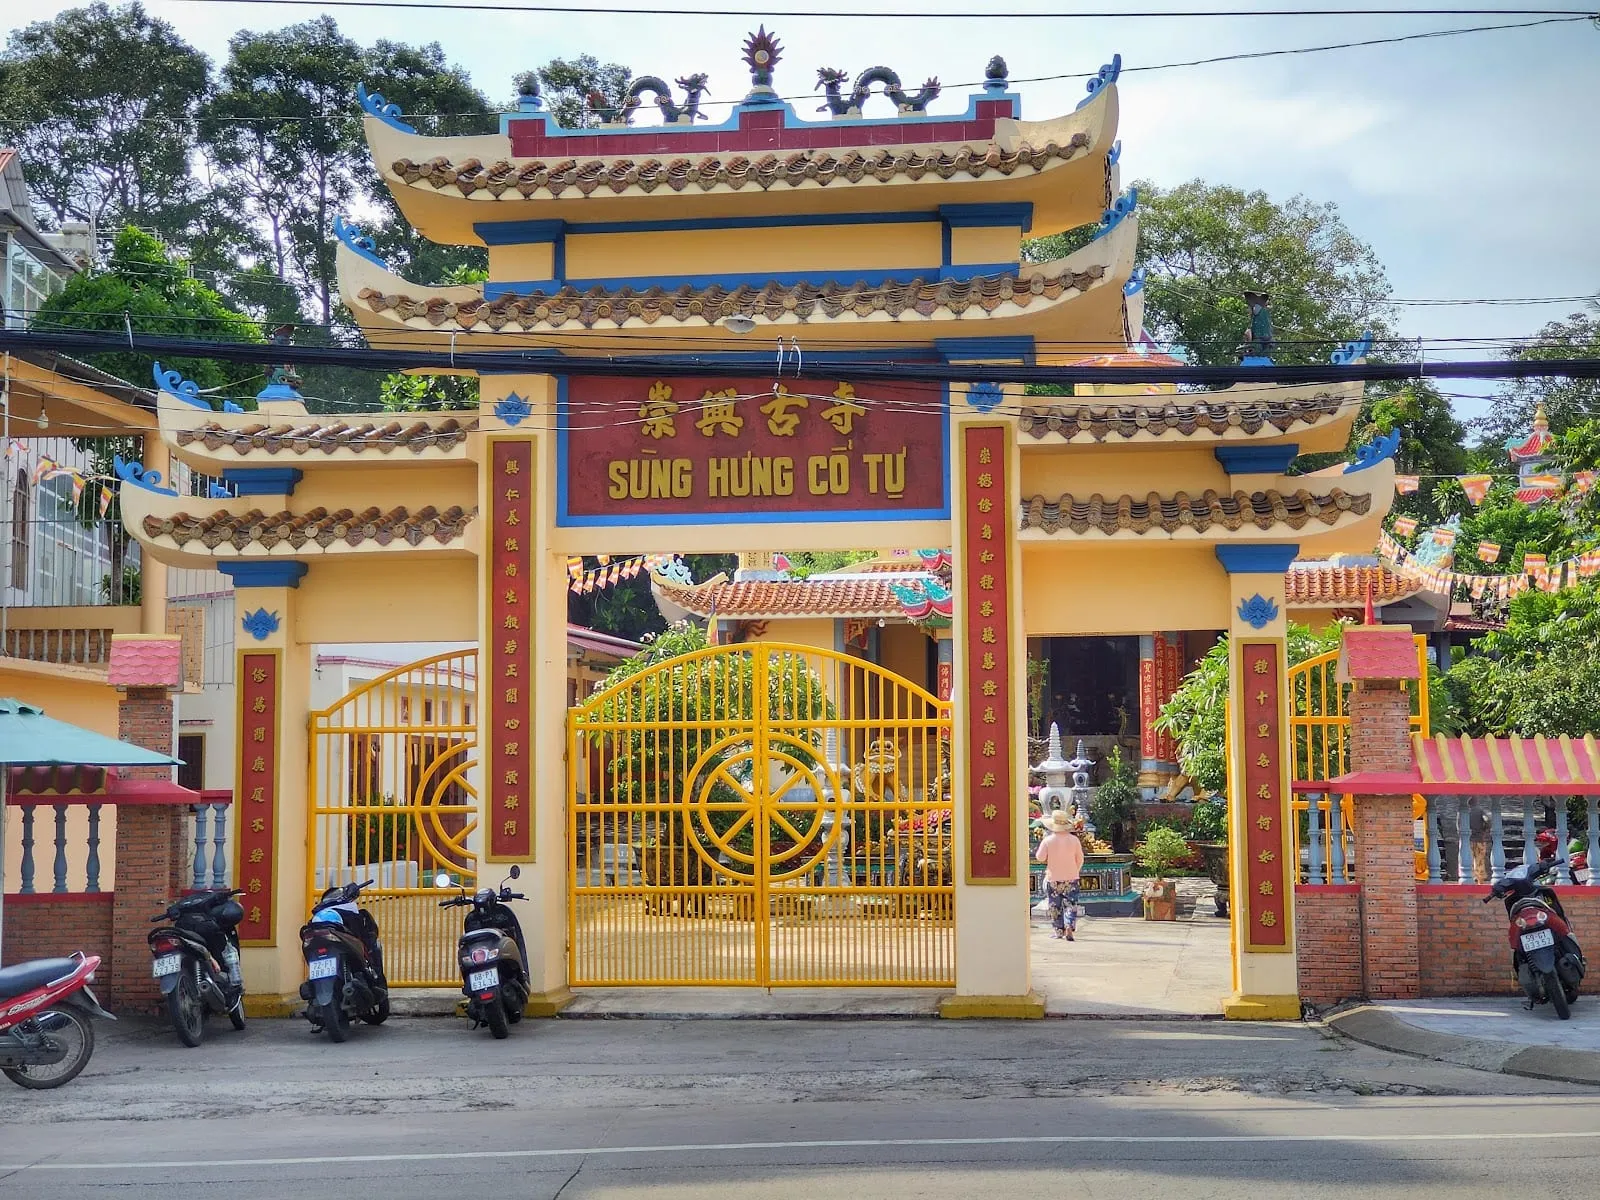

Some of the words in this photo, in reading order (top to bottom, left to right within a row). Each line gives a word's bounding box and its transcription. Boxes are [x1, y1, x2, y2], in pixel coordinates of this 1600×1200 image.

[638, 380, 866, 439] 崇興古寺
[708, 450, 794, 498] HƯNG
[807, 440, 854, 496] CỔ
[863, 446, 908, 500] TỰ
